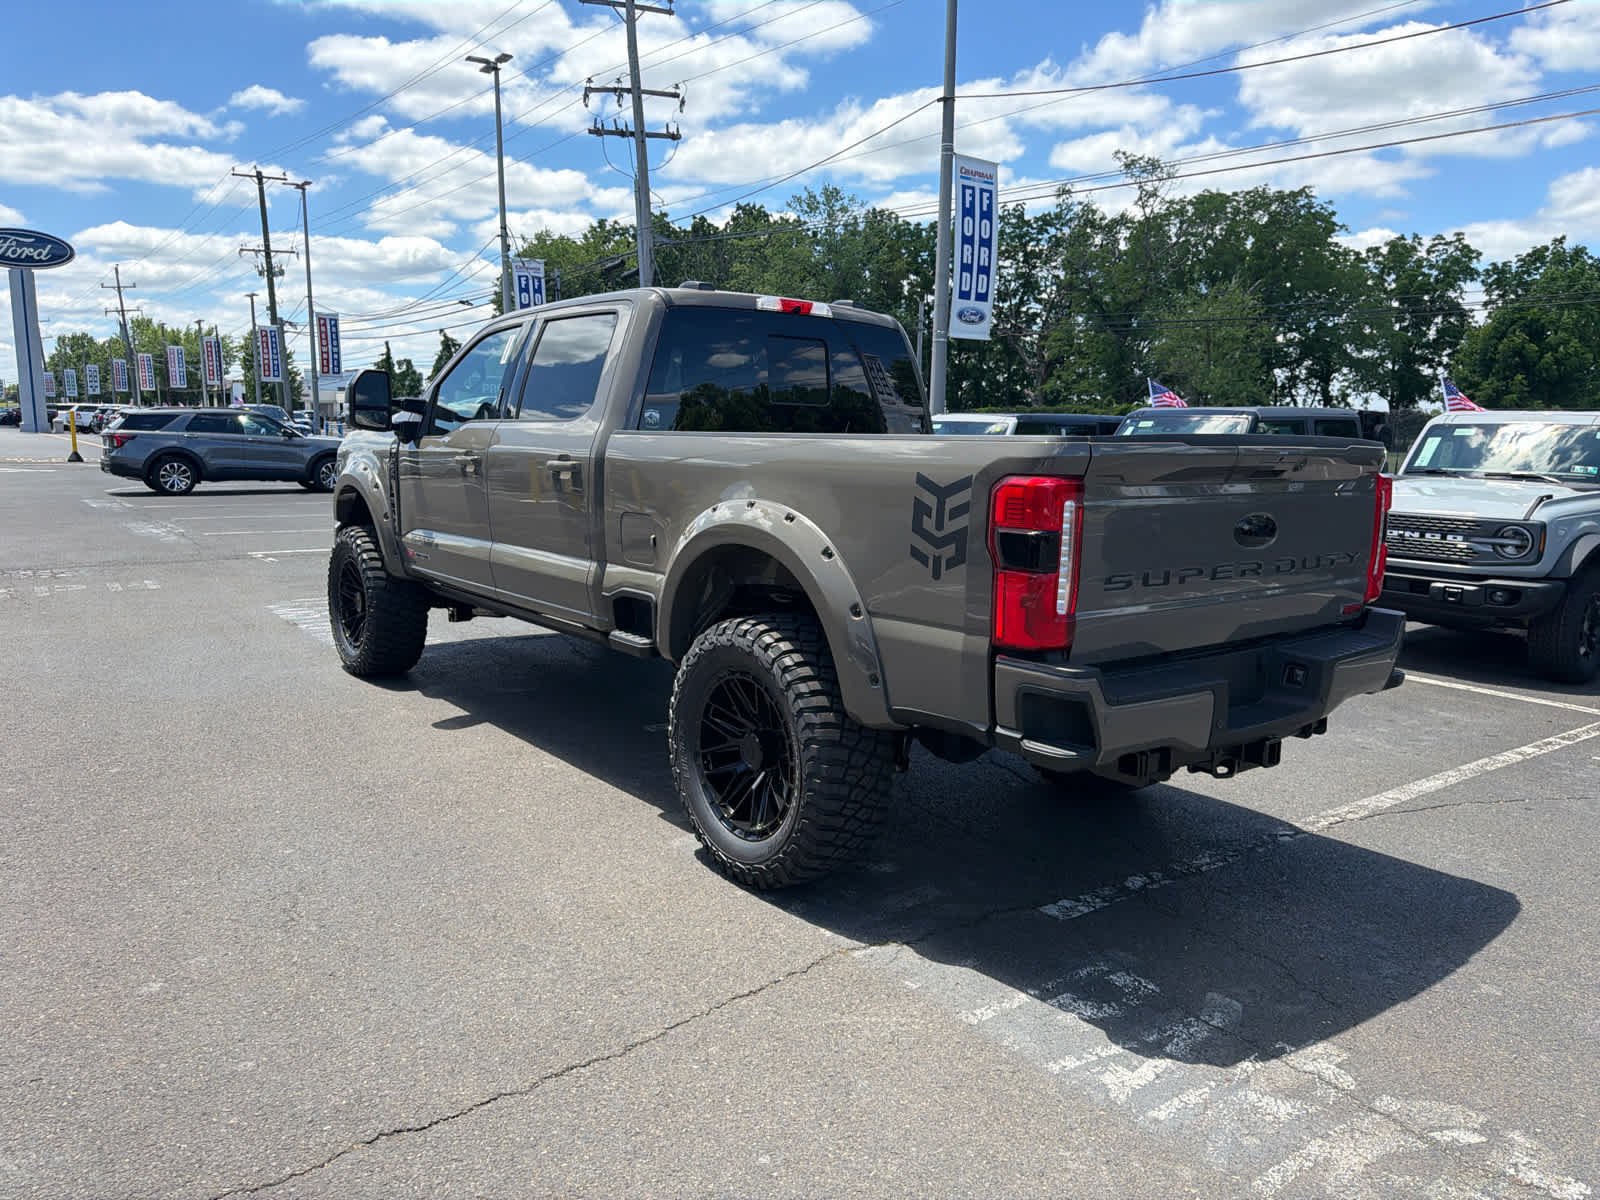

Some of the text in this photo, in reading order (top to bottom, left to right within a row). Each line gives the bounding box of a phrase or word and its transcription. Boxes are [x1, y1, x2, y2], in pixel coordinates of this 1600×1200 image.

[0, 234, 52, 261] Ford
[961, 189, 973, 292] FORD
[978, 192, 990, 294] FORD
[520, 276, 530, 304] FO
[534, 278, 542, 305] FO
[1386, 529, 1464, 542] ONCO
[1103, 551, 1361, 592] SUPER DUTY
